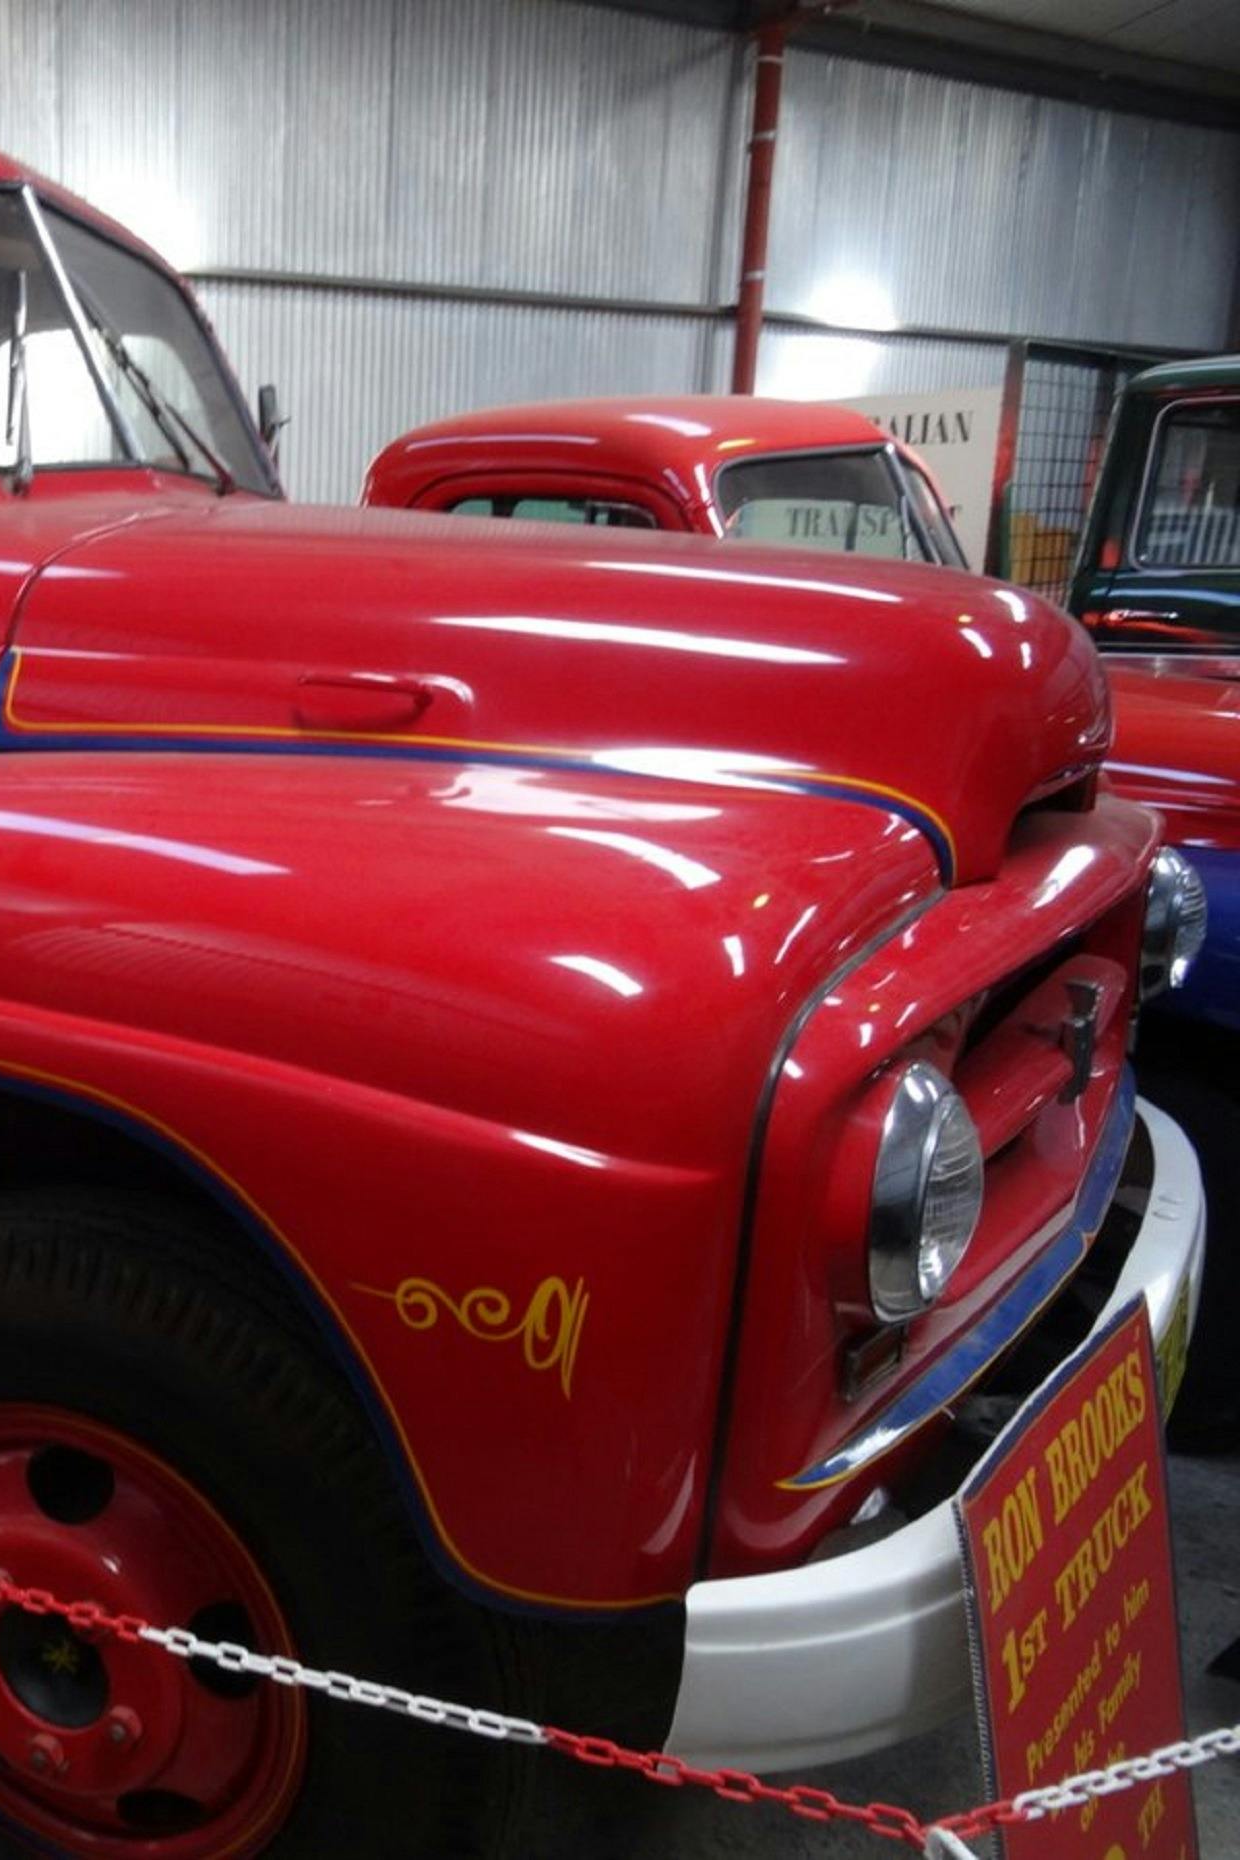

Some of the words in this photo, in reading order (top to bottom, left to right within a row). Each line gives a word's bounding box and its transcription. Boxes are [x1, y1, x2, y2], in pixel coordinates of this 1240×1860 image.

[982, 1466, 1043, 1615] RON
[1055, 1460, 1152, 1632] TRUCK
[1026, 1639, 1101, 1785] Presented
[1105, 1621, 1121, 1655] to
[1123, 1579, 1150, 1627] him
[1099, 1651, 1141, 1736] Family
